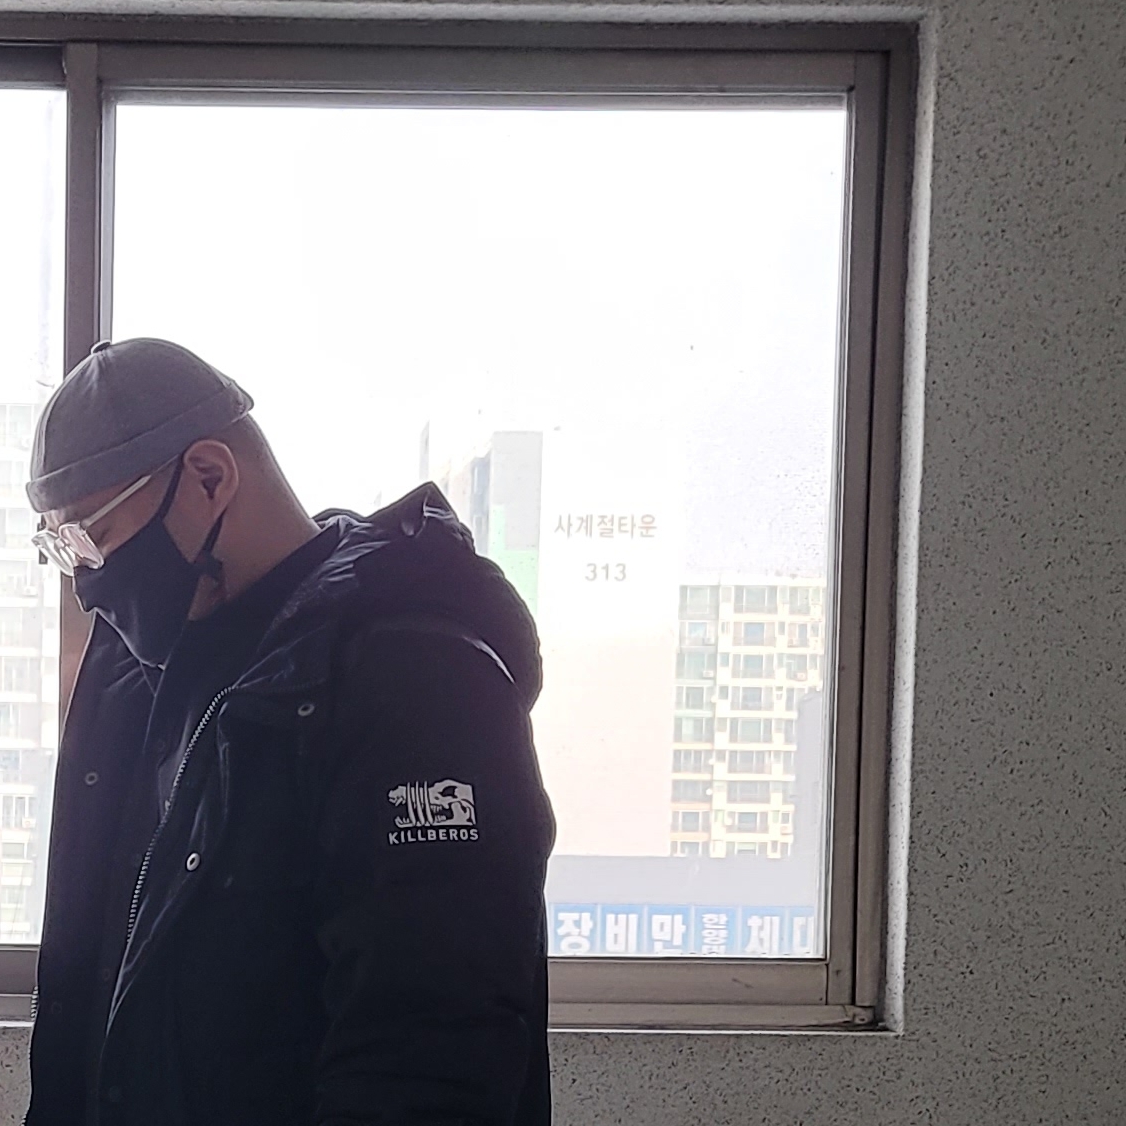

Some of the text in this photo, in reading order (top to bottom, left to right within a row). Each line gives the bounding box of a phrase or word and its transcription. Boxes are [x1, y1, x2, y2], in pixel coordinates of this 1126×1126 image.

[554, 513, 658, 539] 사계절타운
[585, 562, 627, 582] 313
[388, 828, 479, 845] KILLBEROS
[556, 912, 687, 955] 장비만
